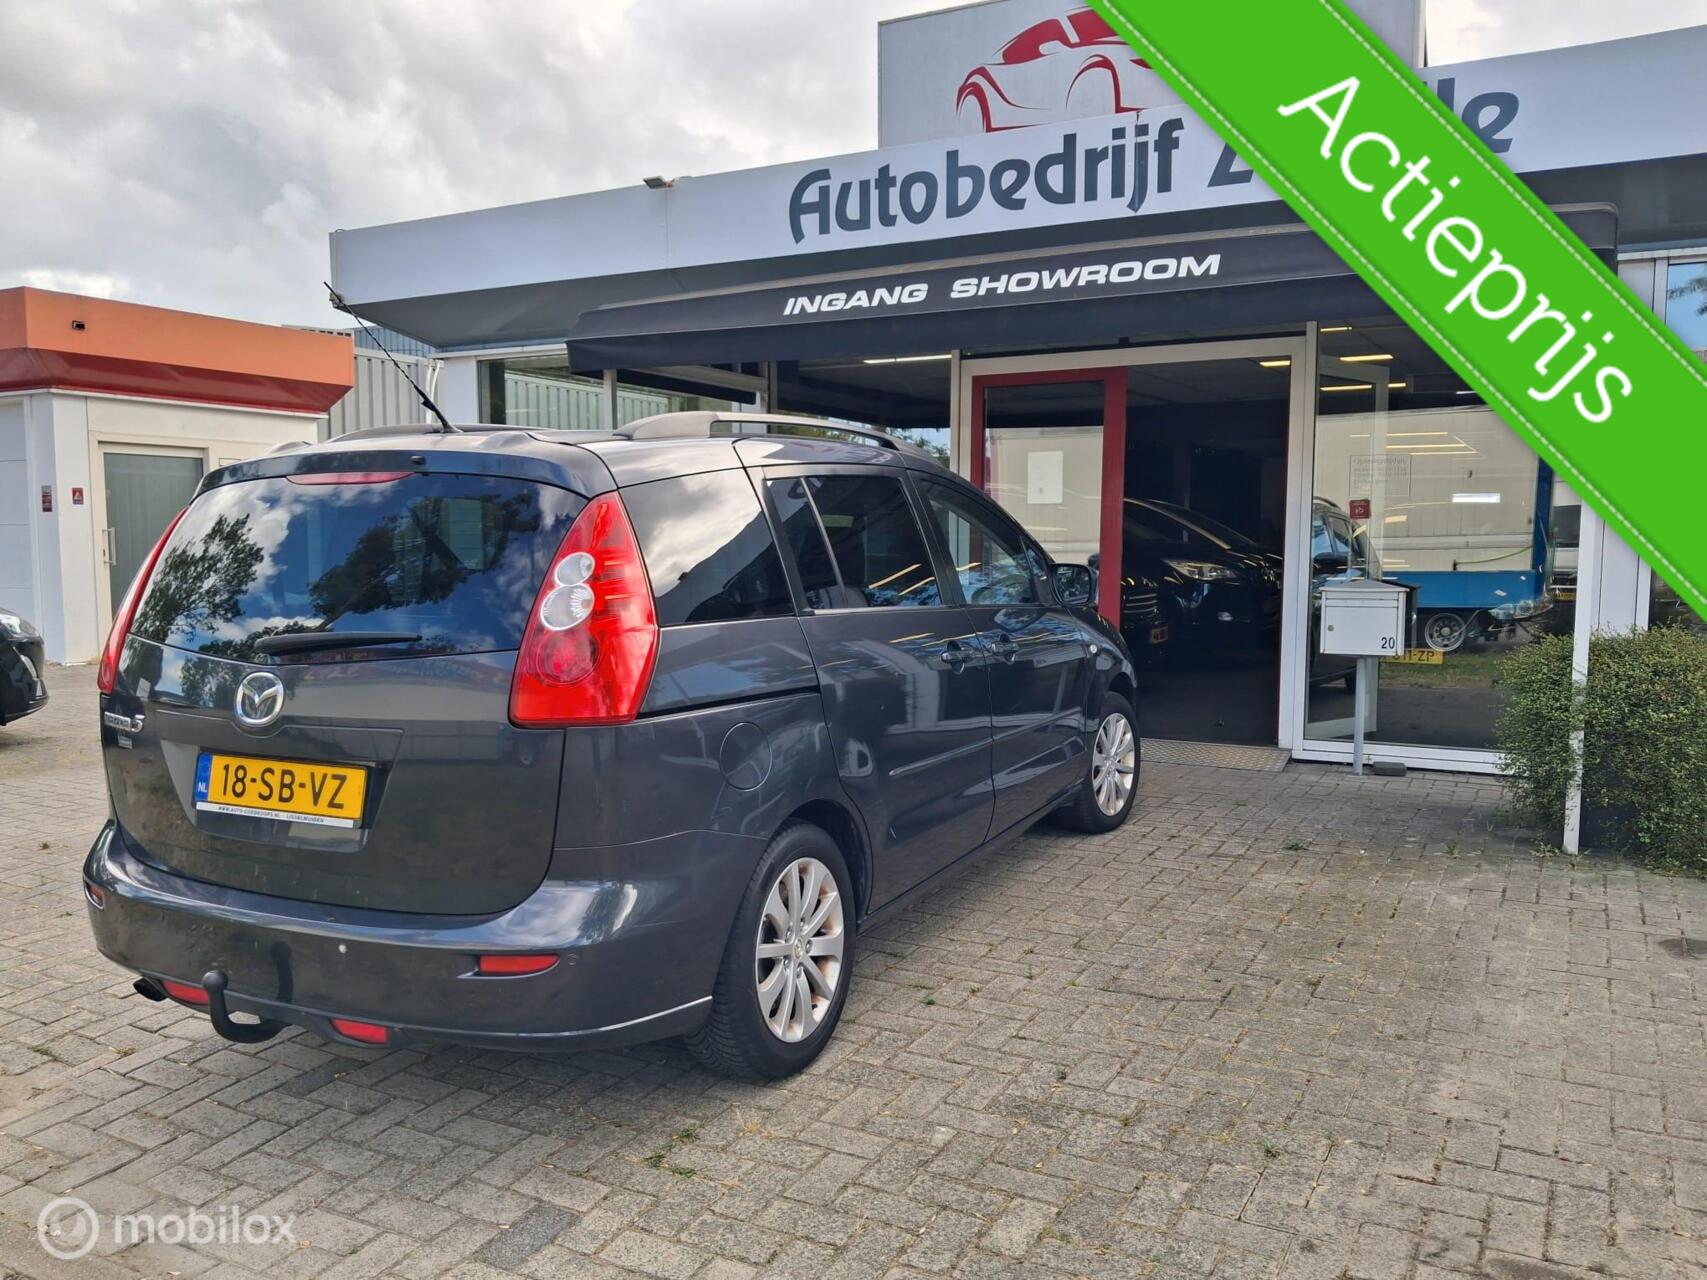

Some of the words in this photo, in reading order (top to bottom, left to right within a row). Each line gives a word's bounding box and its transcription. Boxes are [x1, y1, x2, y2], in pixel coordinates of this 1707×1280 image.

[789, 117, 1184, 245] Autobedrijf
[783, 283, 928, 316] INGANG
[950, 254, 1221, 299] SHOWROOM
[1381, 636, 1396, 650] 20
[198, 782, 207, 793] NL
[222, 763, 347, 810] 18-SB-VZ
